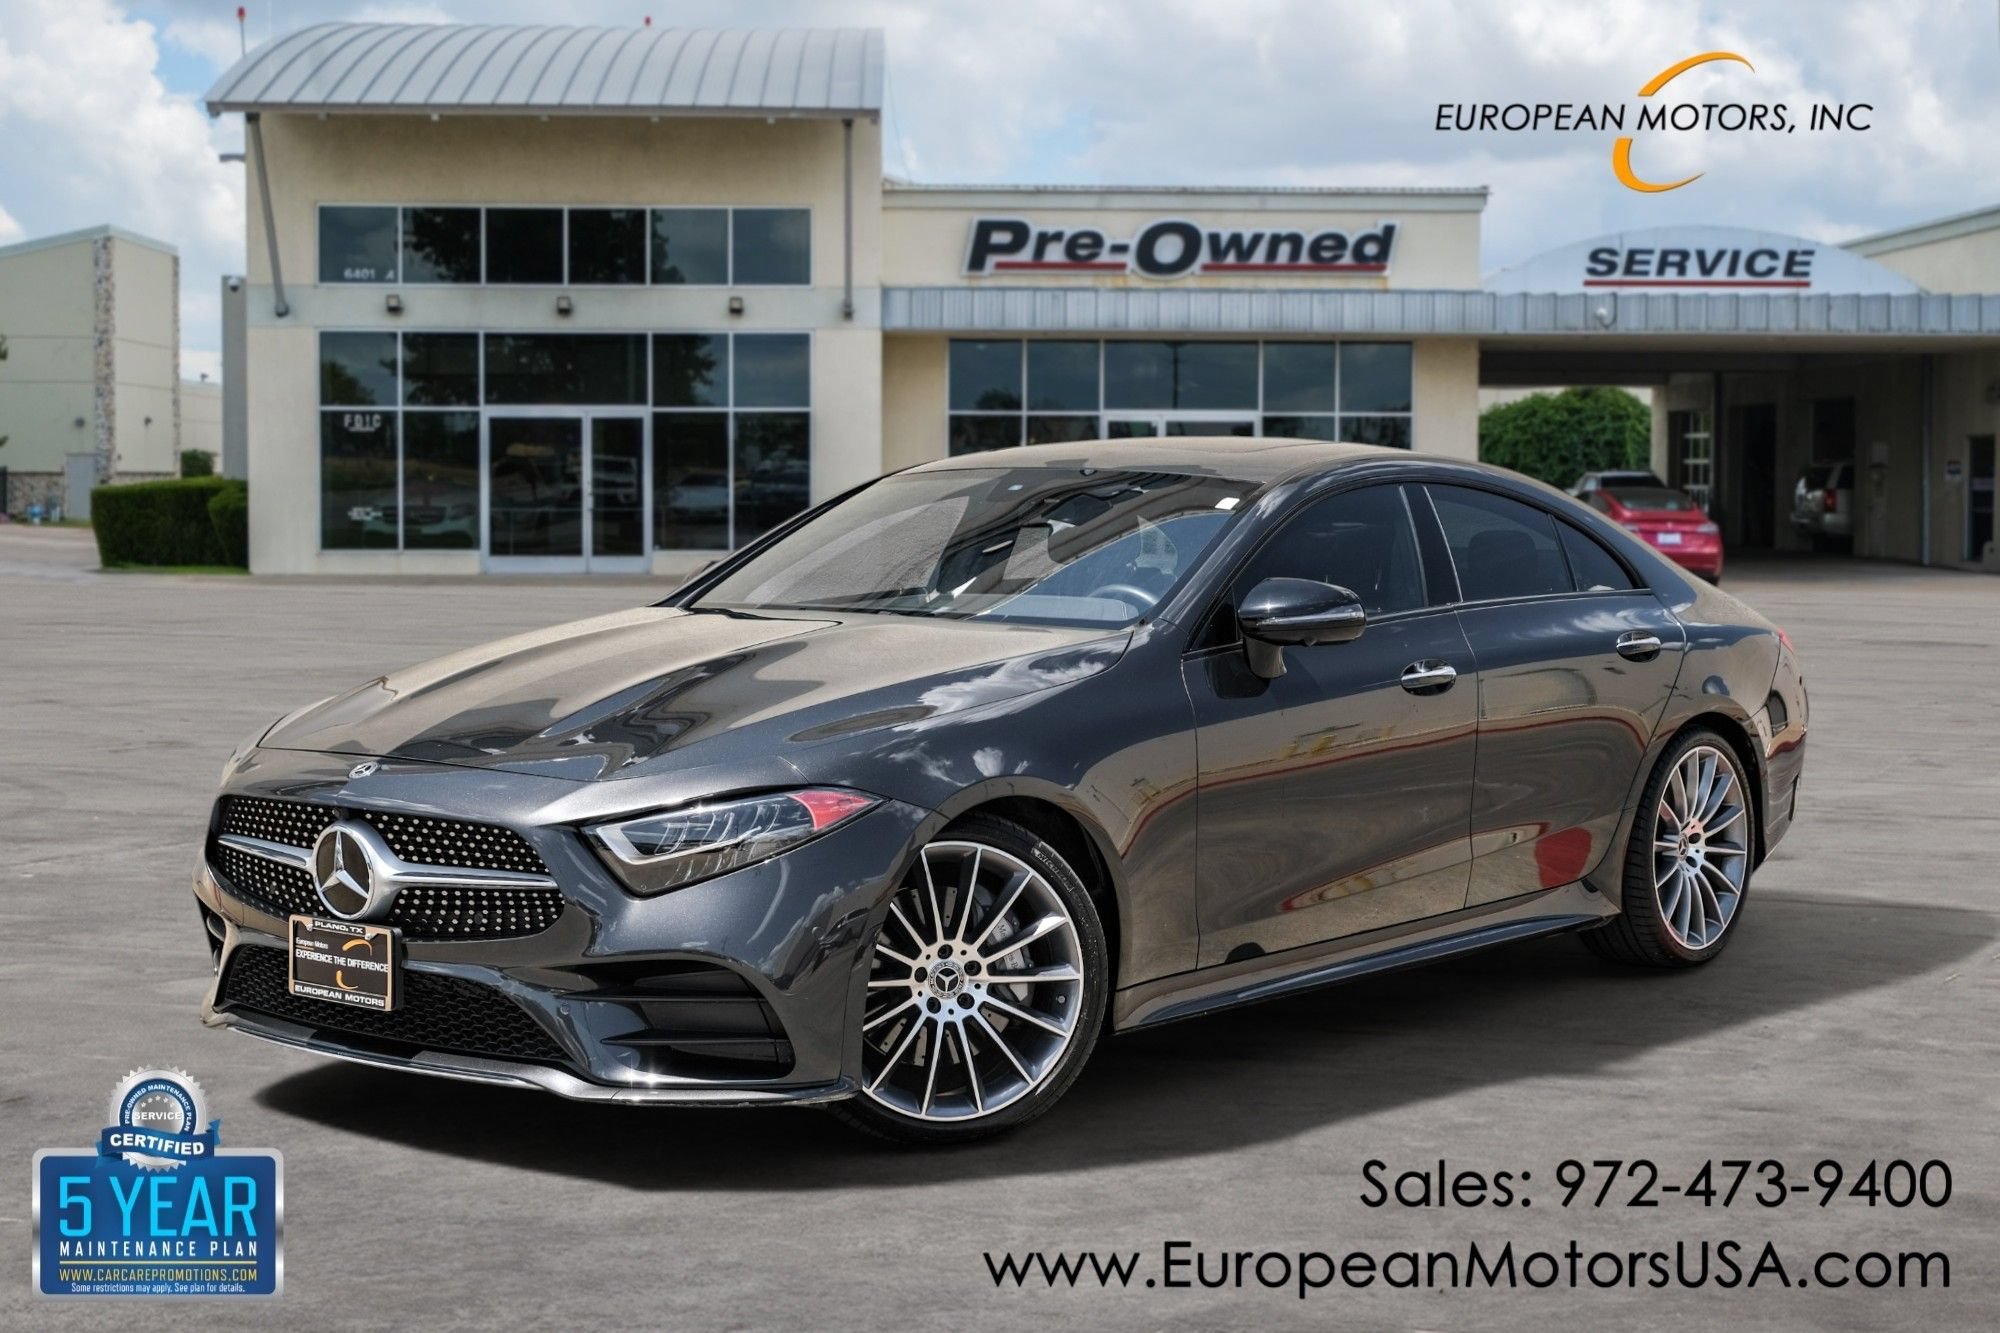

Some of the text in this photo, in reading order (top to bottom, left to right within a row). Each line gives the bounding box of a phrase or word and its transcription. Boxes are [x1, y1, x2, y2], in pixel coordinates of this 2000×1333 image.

[966, 220, 1397, 276] Pre-Owned
[1585, 247, 1815, 278] SERVICE
[295, 948, 388, 973] EXPERIENCE THE DIFFERENCE
[294, 984, 385, 1007] EUROPEAN MOTORS
